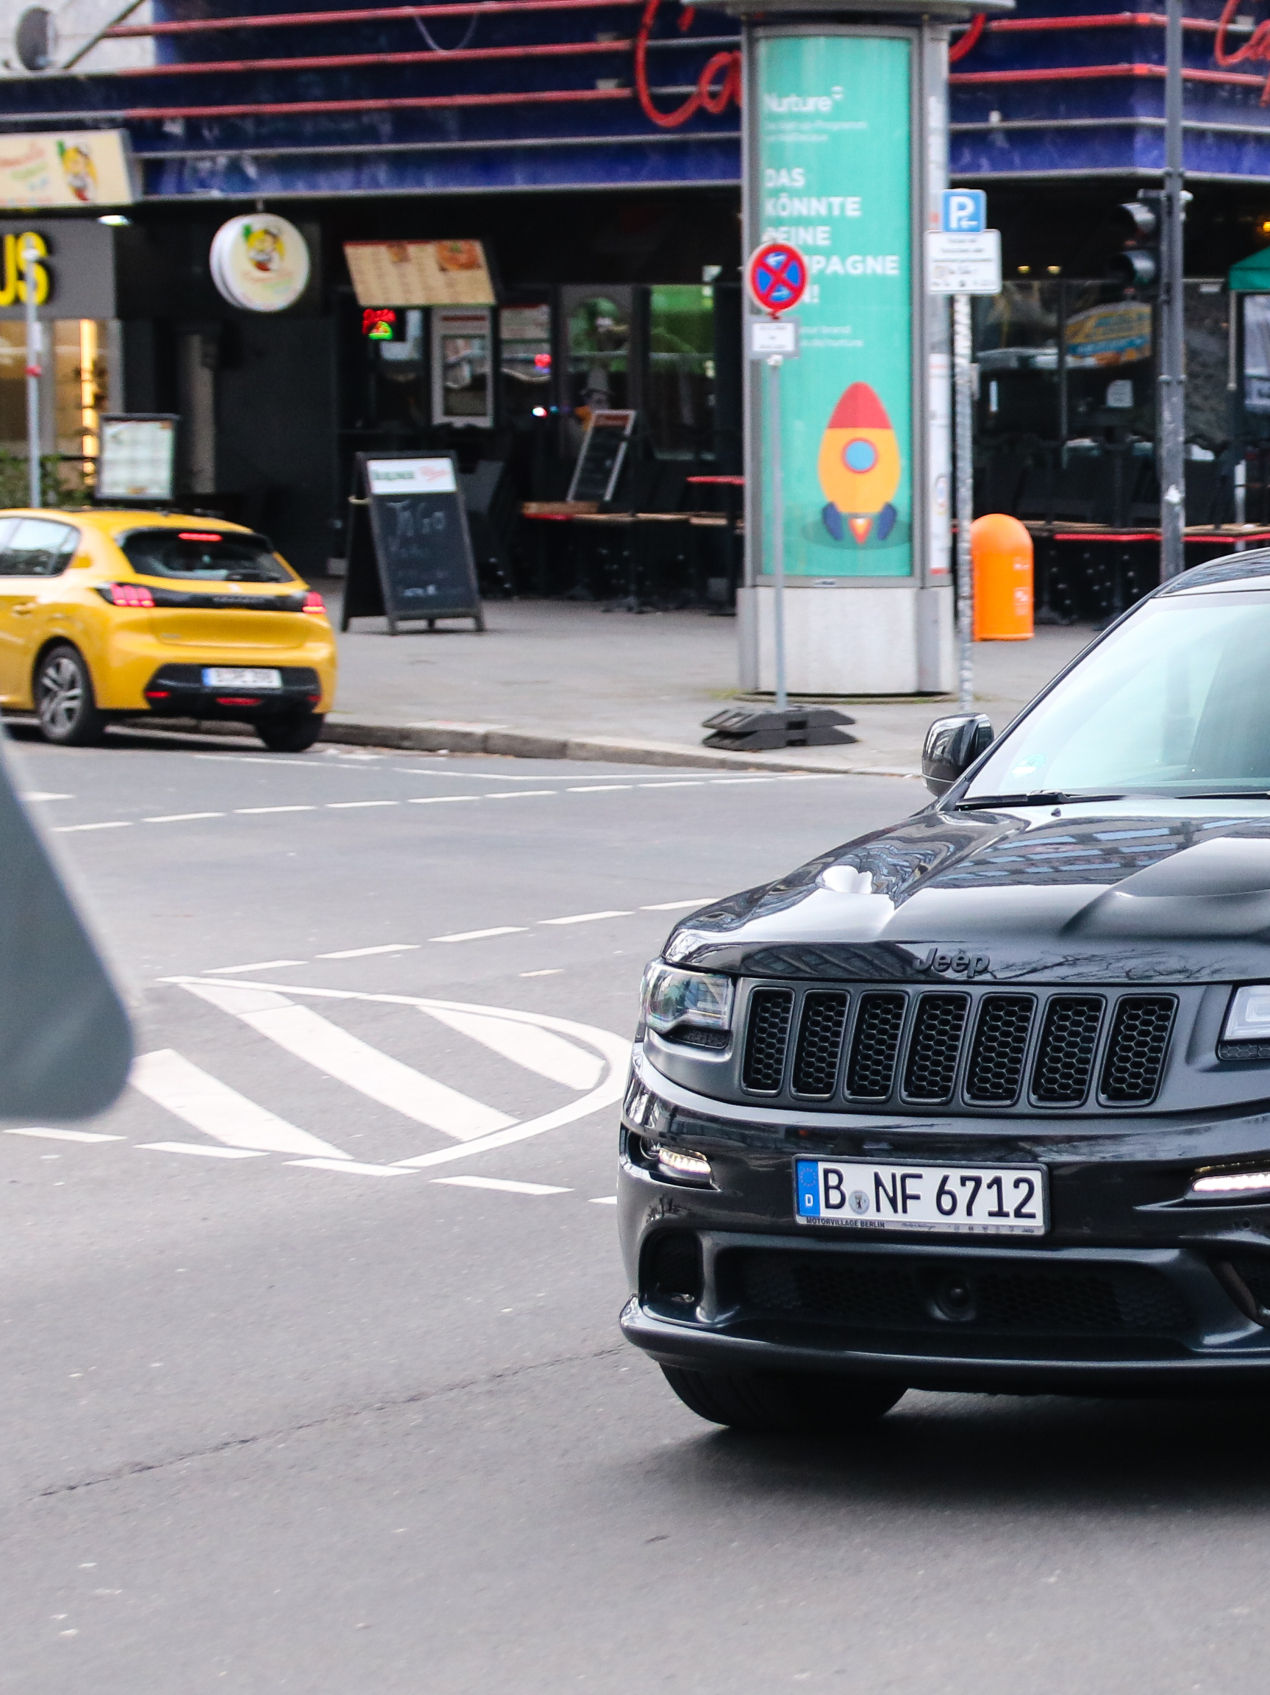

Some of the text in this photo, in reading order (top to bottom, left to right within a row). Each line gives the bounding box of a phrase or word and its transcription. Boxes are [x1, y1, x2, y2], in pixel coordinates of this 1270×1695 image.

[764, 168, 805, 188] DAS
[764, 193, 862, 218] KÖNNTE
[949, 196, 975, 228] P
[912, 947, 990, 979] Jeep
[805, 1194, 814, 1207] D
[823, 1168, 1037, 1219] B NF 6712
